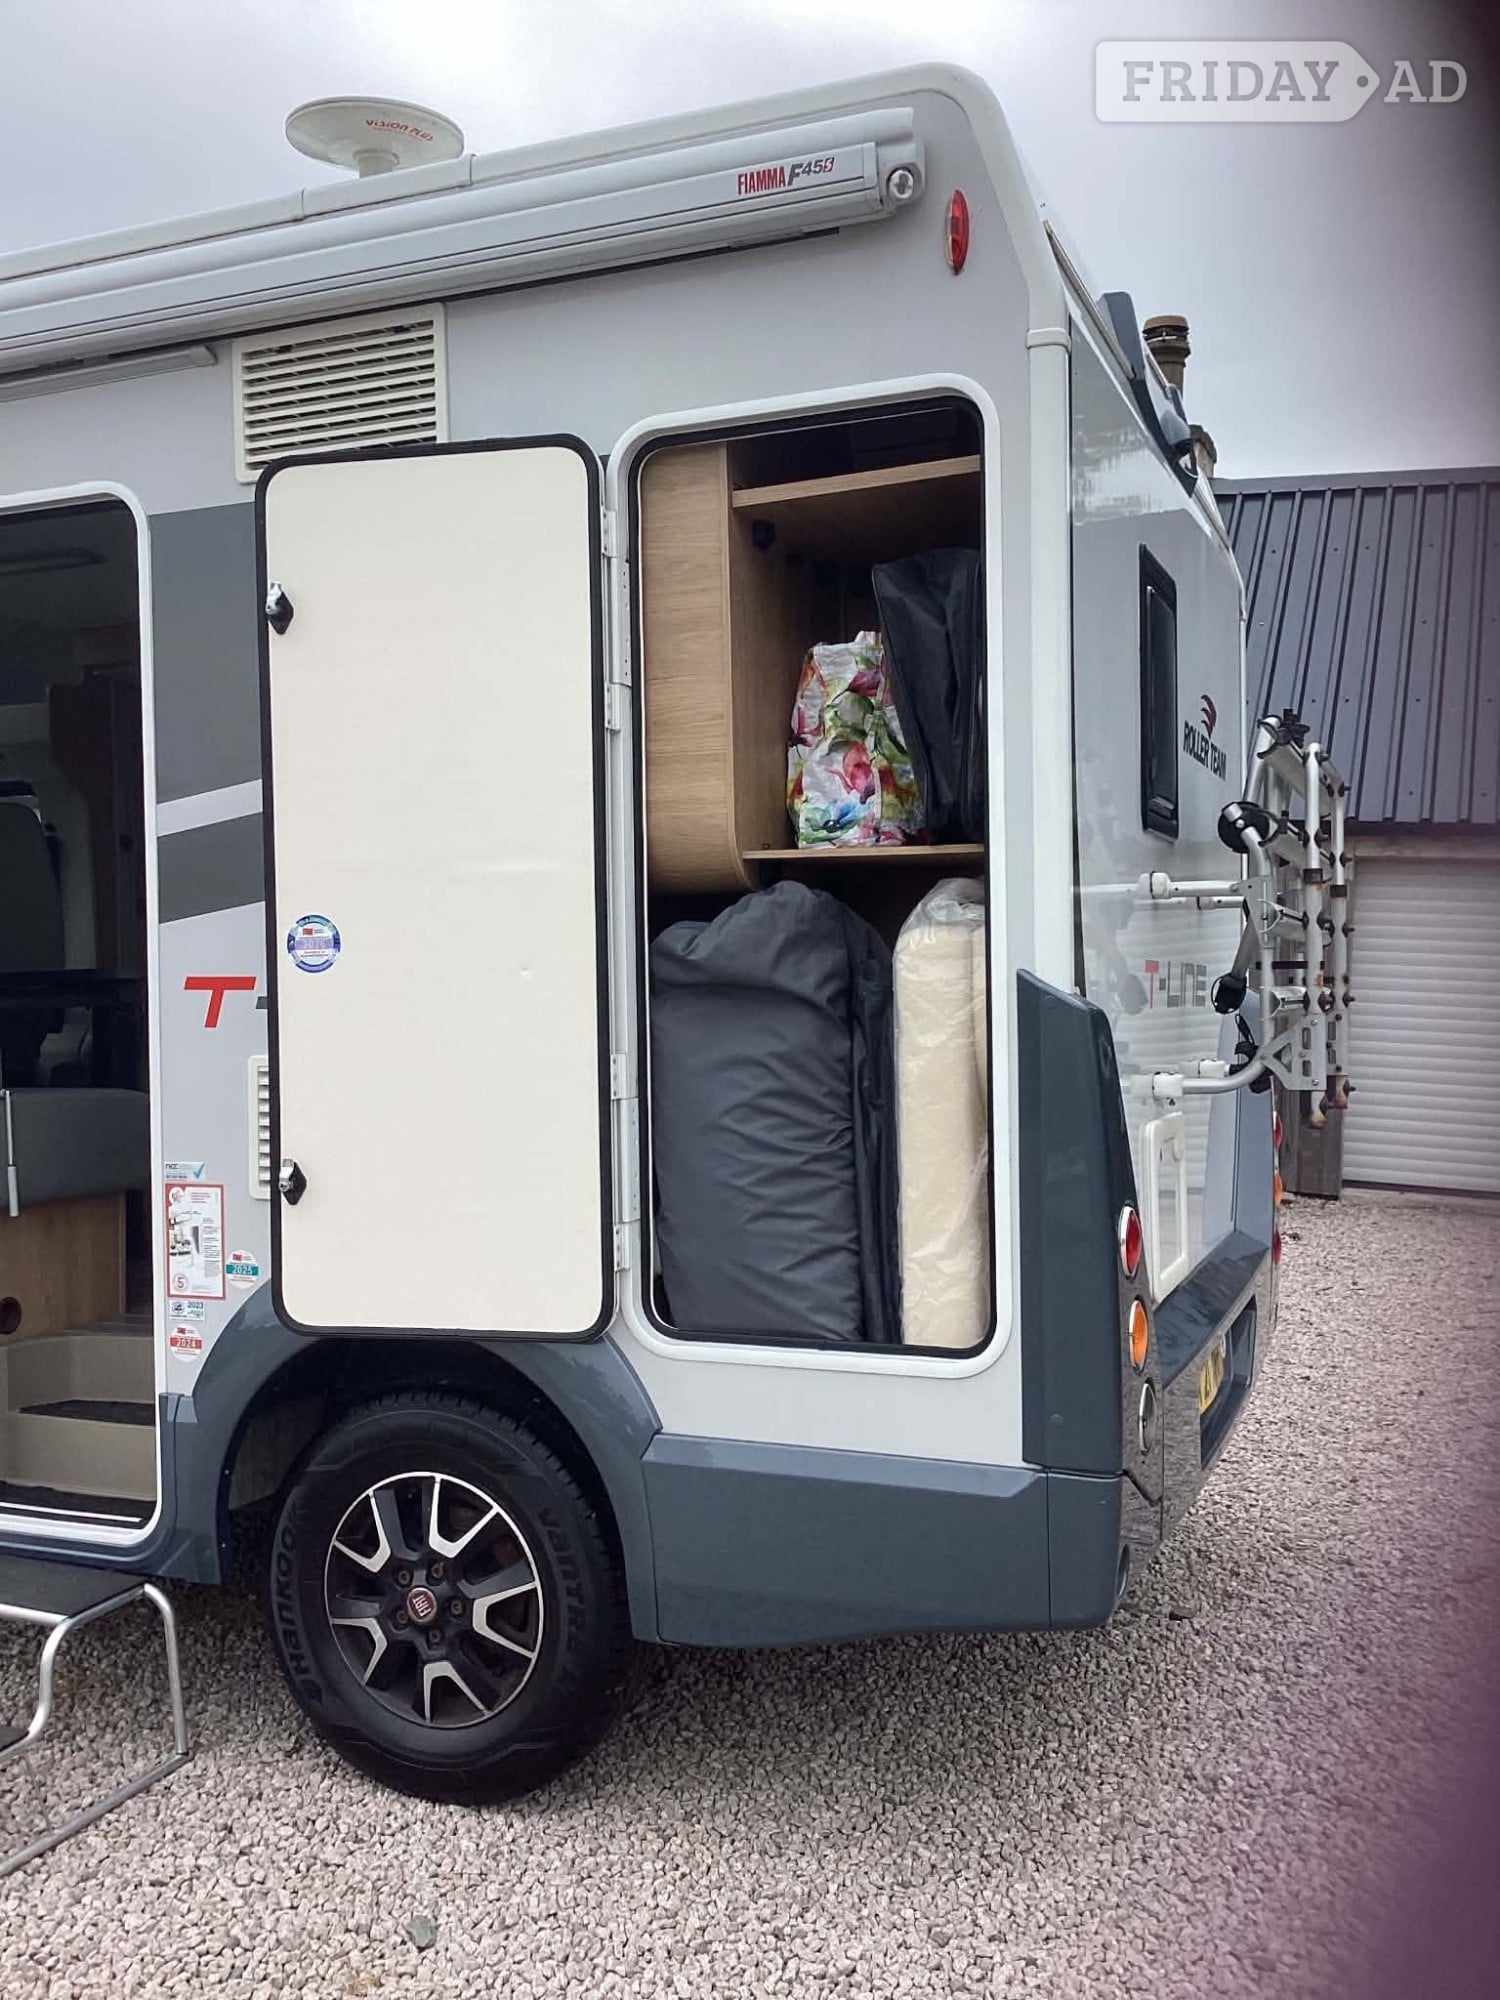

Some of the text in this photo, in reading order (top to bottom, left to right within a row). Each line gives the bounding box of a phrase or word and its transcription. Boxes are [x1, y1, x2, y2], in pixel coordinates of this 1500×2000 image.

[737, 166, 786, 196] FIAMMA
[1183, 720, 1227, 781] ROLLER TEAM
[177, 1276, 185, 1289] 5
[177, 1338, 196, 1349] 2024
[412, 1595, 432, 1617] FIAT
